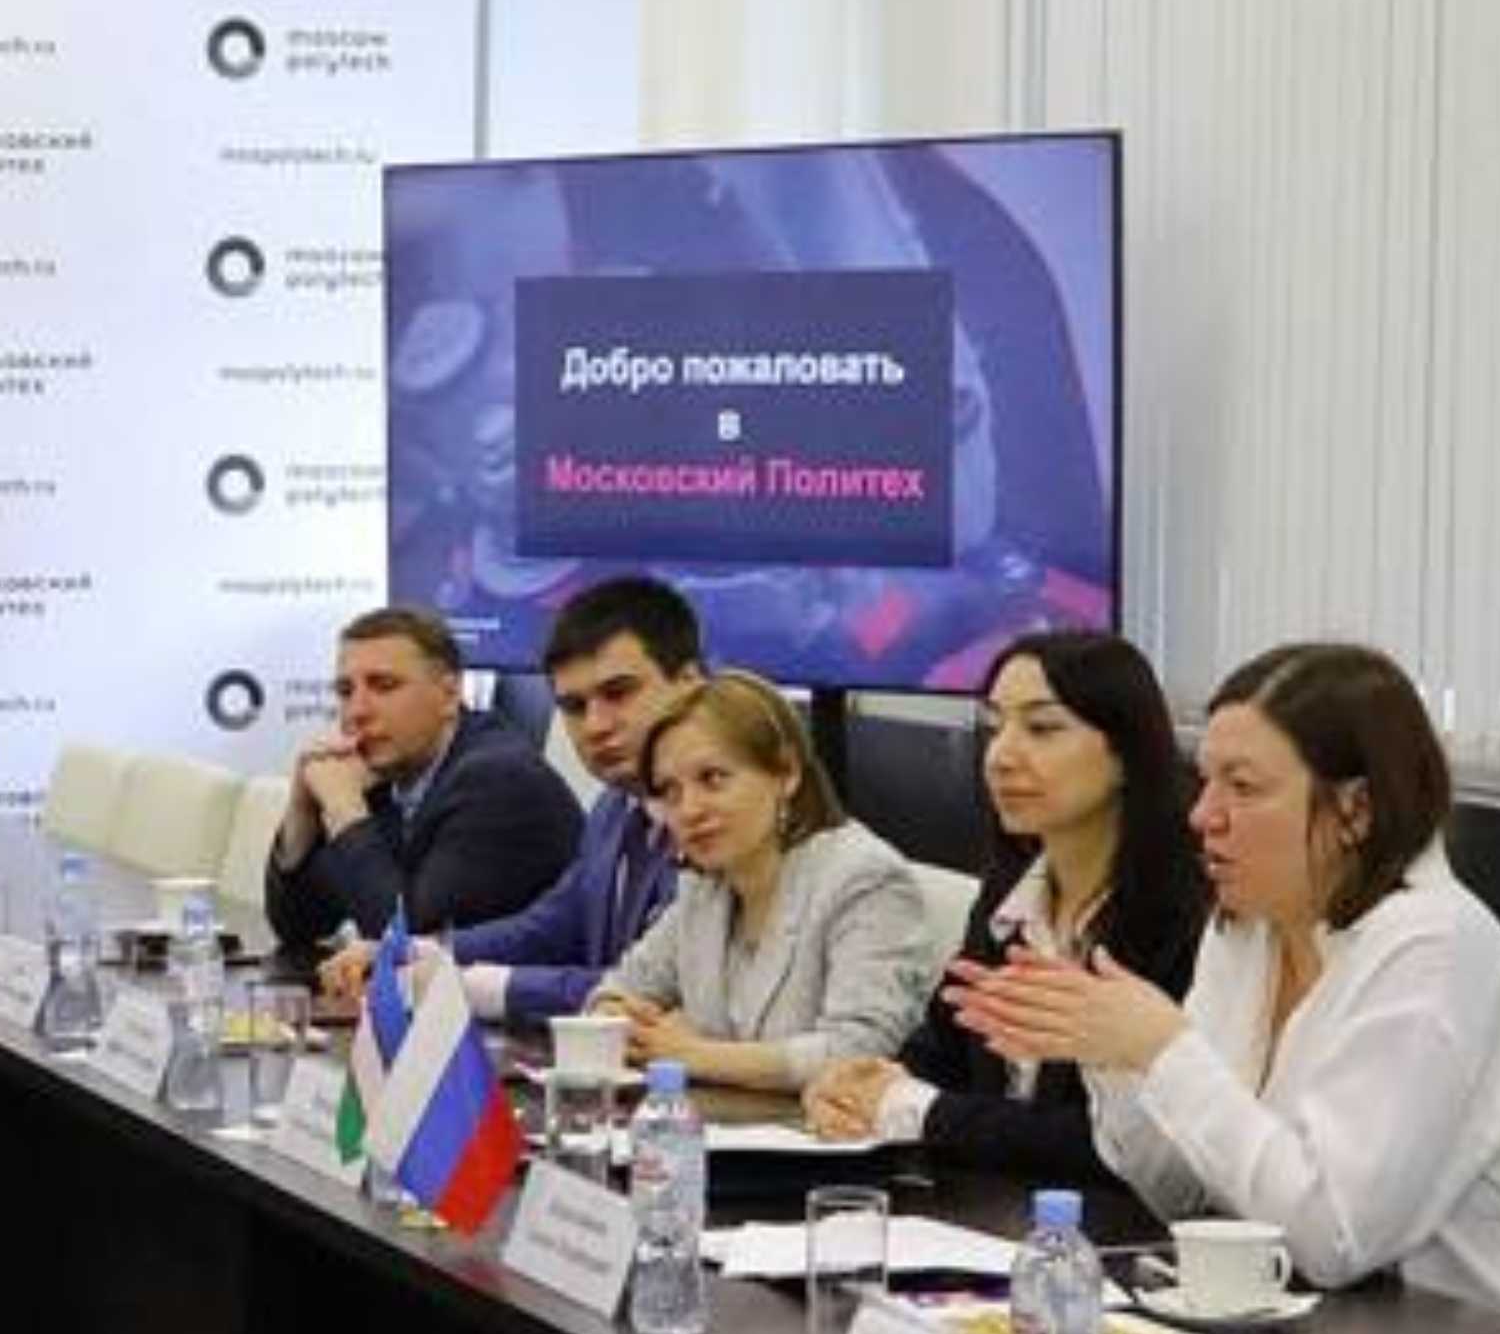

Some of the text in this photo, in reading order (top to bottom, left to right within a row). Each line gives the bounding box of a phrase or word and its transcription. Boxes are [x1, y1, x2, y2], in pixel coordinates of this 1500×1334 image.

[560, 347, 904, 393] Добро пожаловать
[549, 455, 924, 499] Московский Политех
